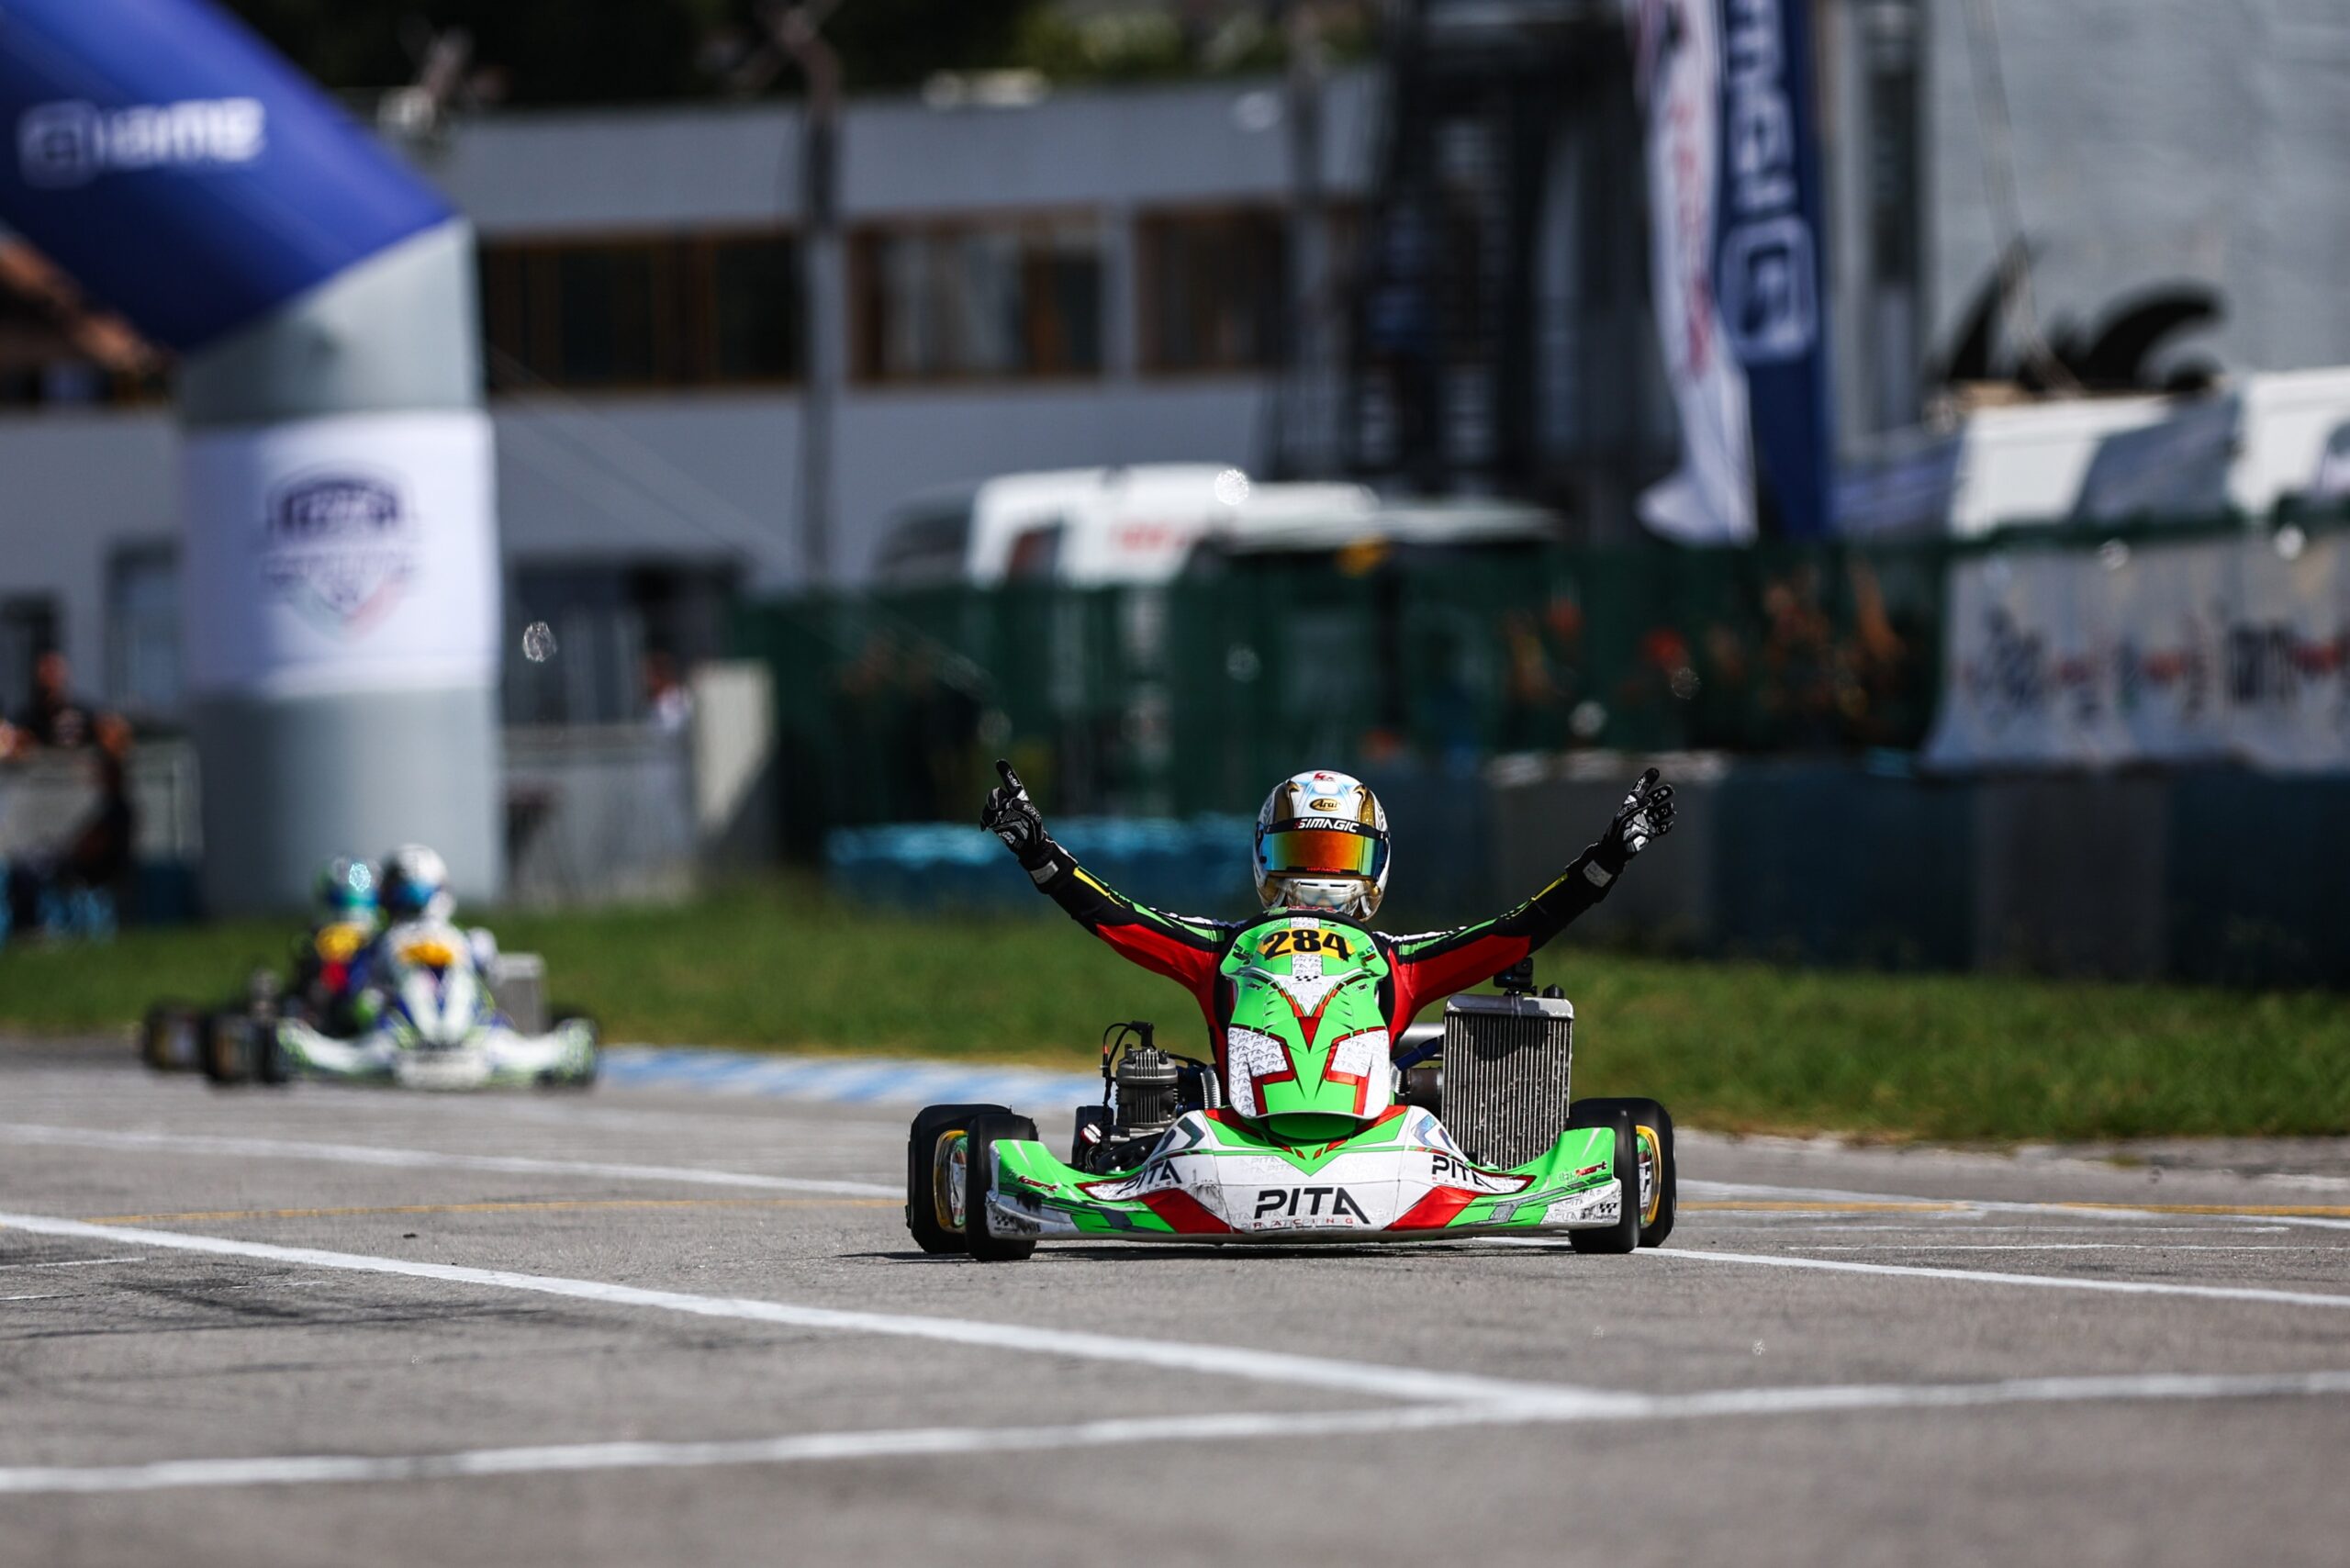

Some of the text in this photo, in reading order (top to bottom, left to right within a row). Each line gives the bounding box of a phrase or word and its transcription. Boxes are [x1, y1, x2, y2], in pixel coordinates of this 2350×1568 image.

[1312, 799, 1338, 809] Arai
[1298, 818, 1360, 834] SIMAGIC
[1262, 929, 1352, 962] 284
[1115, 1159, 1182, 1194] PITA
[1432, 1155, 1500, 1192] PITA
[1254, 1187, 1371, 1225] PITA
[1254, 1217, 1354, 1229] RACING
